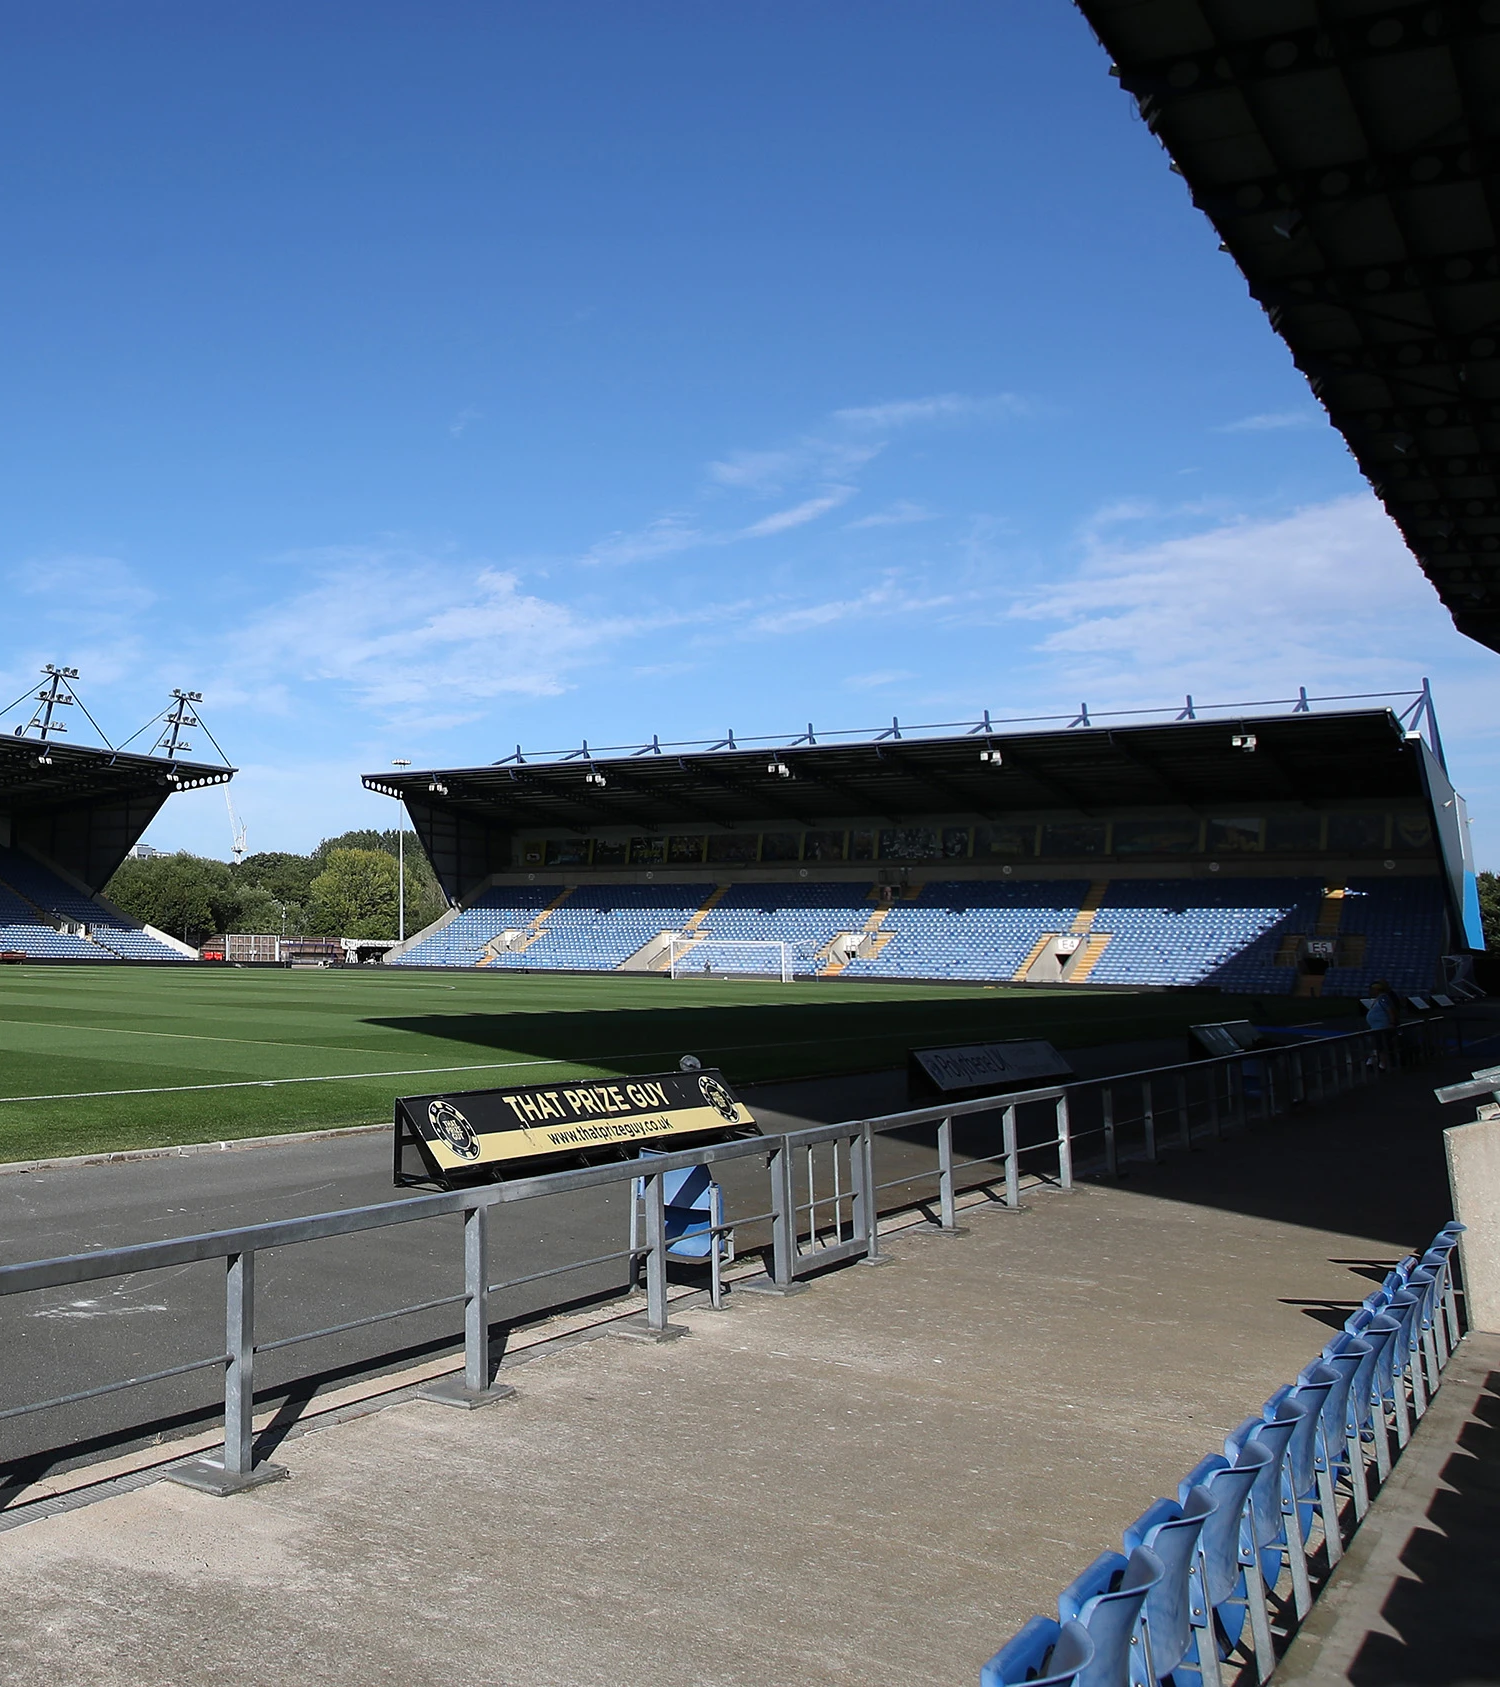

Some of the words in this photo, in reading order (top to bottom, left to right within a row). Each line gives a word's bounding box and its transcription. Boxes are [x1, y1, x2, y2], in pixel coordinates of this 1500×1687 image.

[1062, 939, 1075, 949] E4
[1312, 942, 1328, 953] E5
[502, 1091, 567, 1122] THAT
[562, 1085, 632, 1116] PRIZE
[626, 1082, 670, 1108] GUY
[445, 1126, 463, 1135] PRIZE
[547, 1115, 674, 1146] www.thatprizeguy.co.uk
